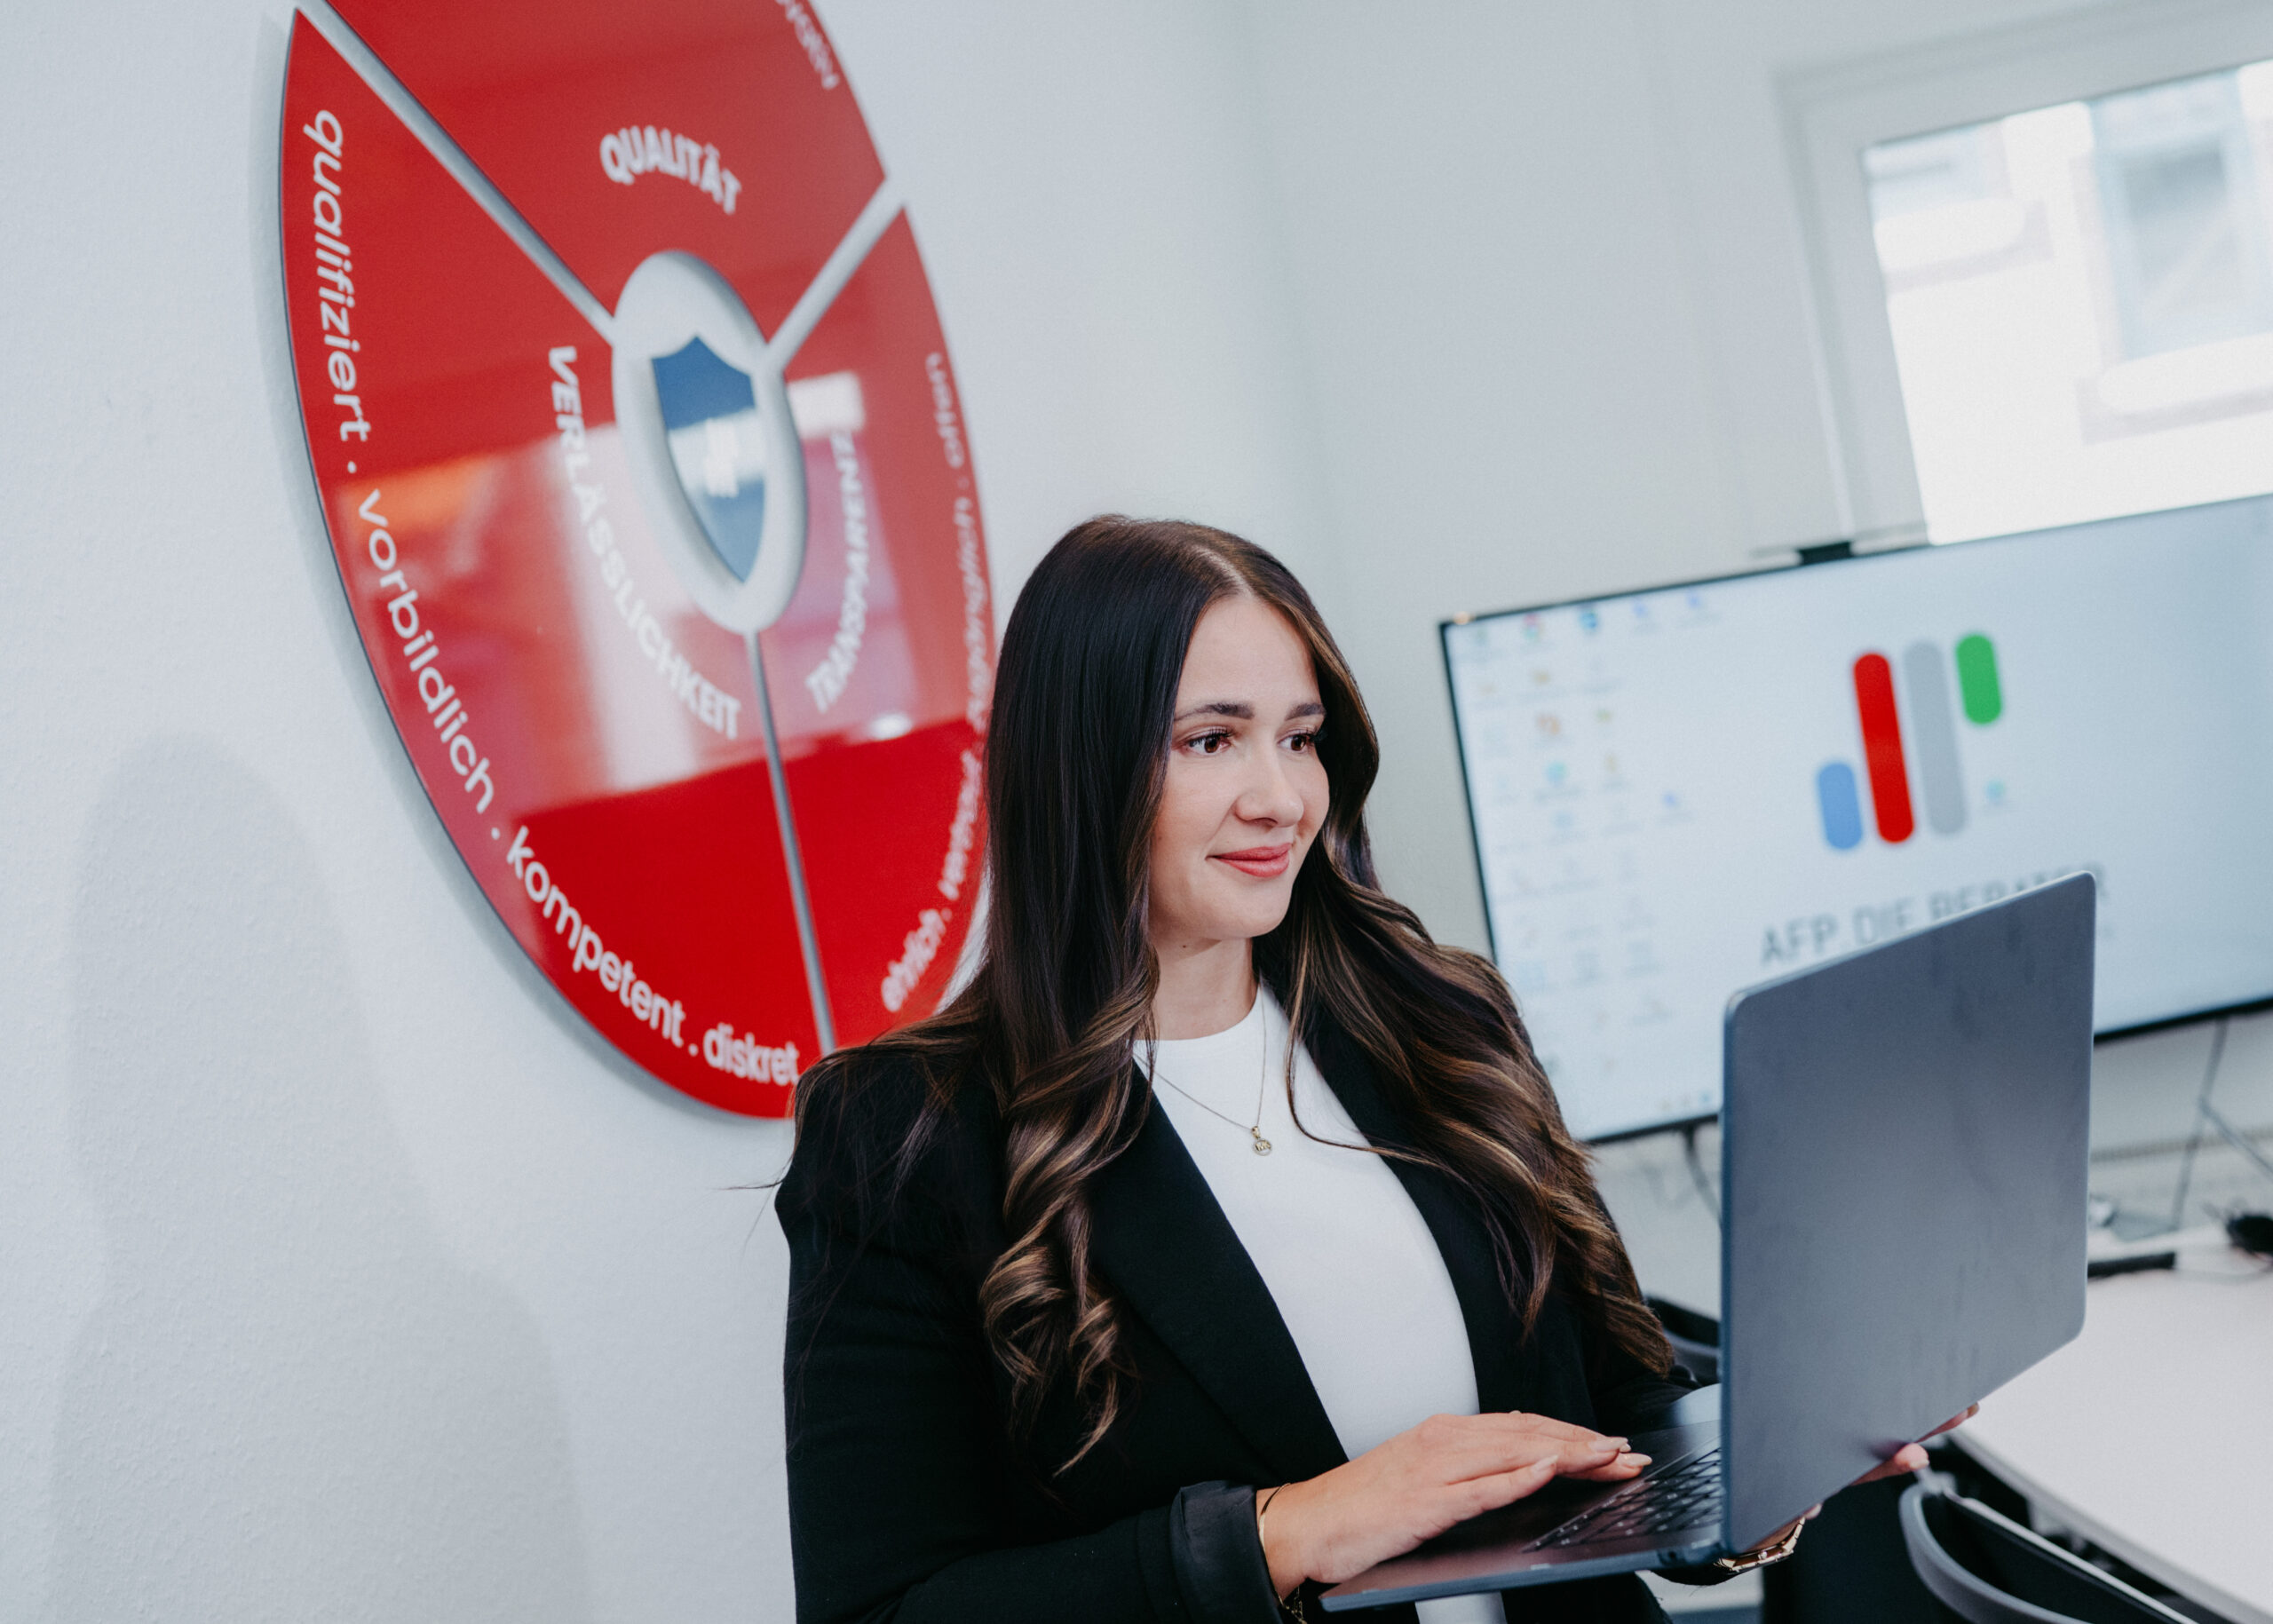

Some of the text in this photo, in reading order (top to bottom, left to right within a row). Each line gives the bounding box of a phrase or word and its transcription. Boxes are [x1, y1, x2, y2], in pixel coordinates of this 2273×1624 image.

[599, 125, 742, 216] QUALITÄT
[303, 110, 800, 1086] qualifiziert vorbildlich kompetent diskret
[548, 345, 741, 741] VERLÄSSLICHKEIT
[1760, 911, 1839, 968] AFP
